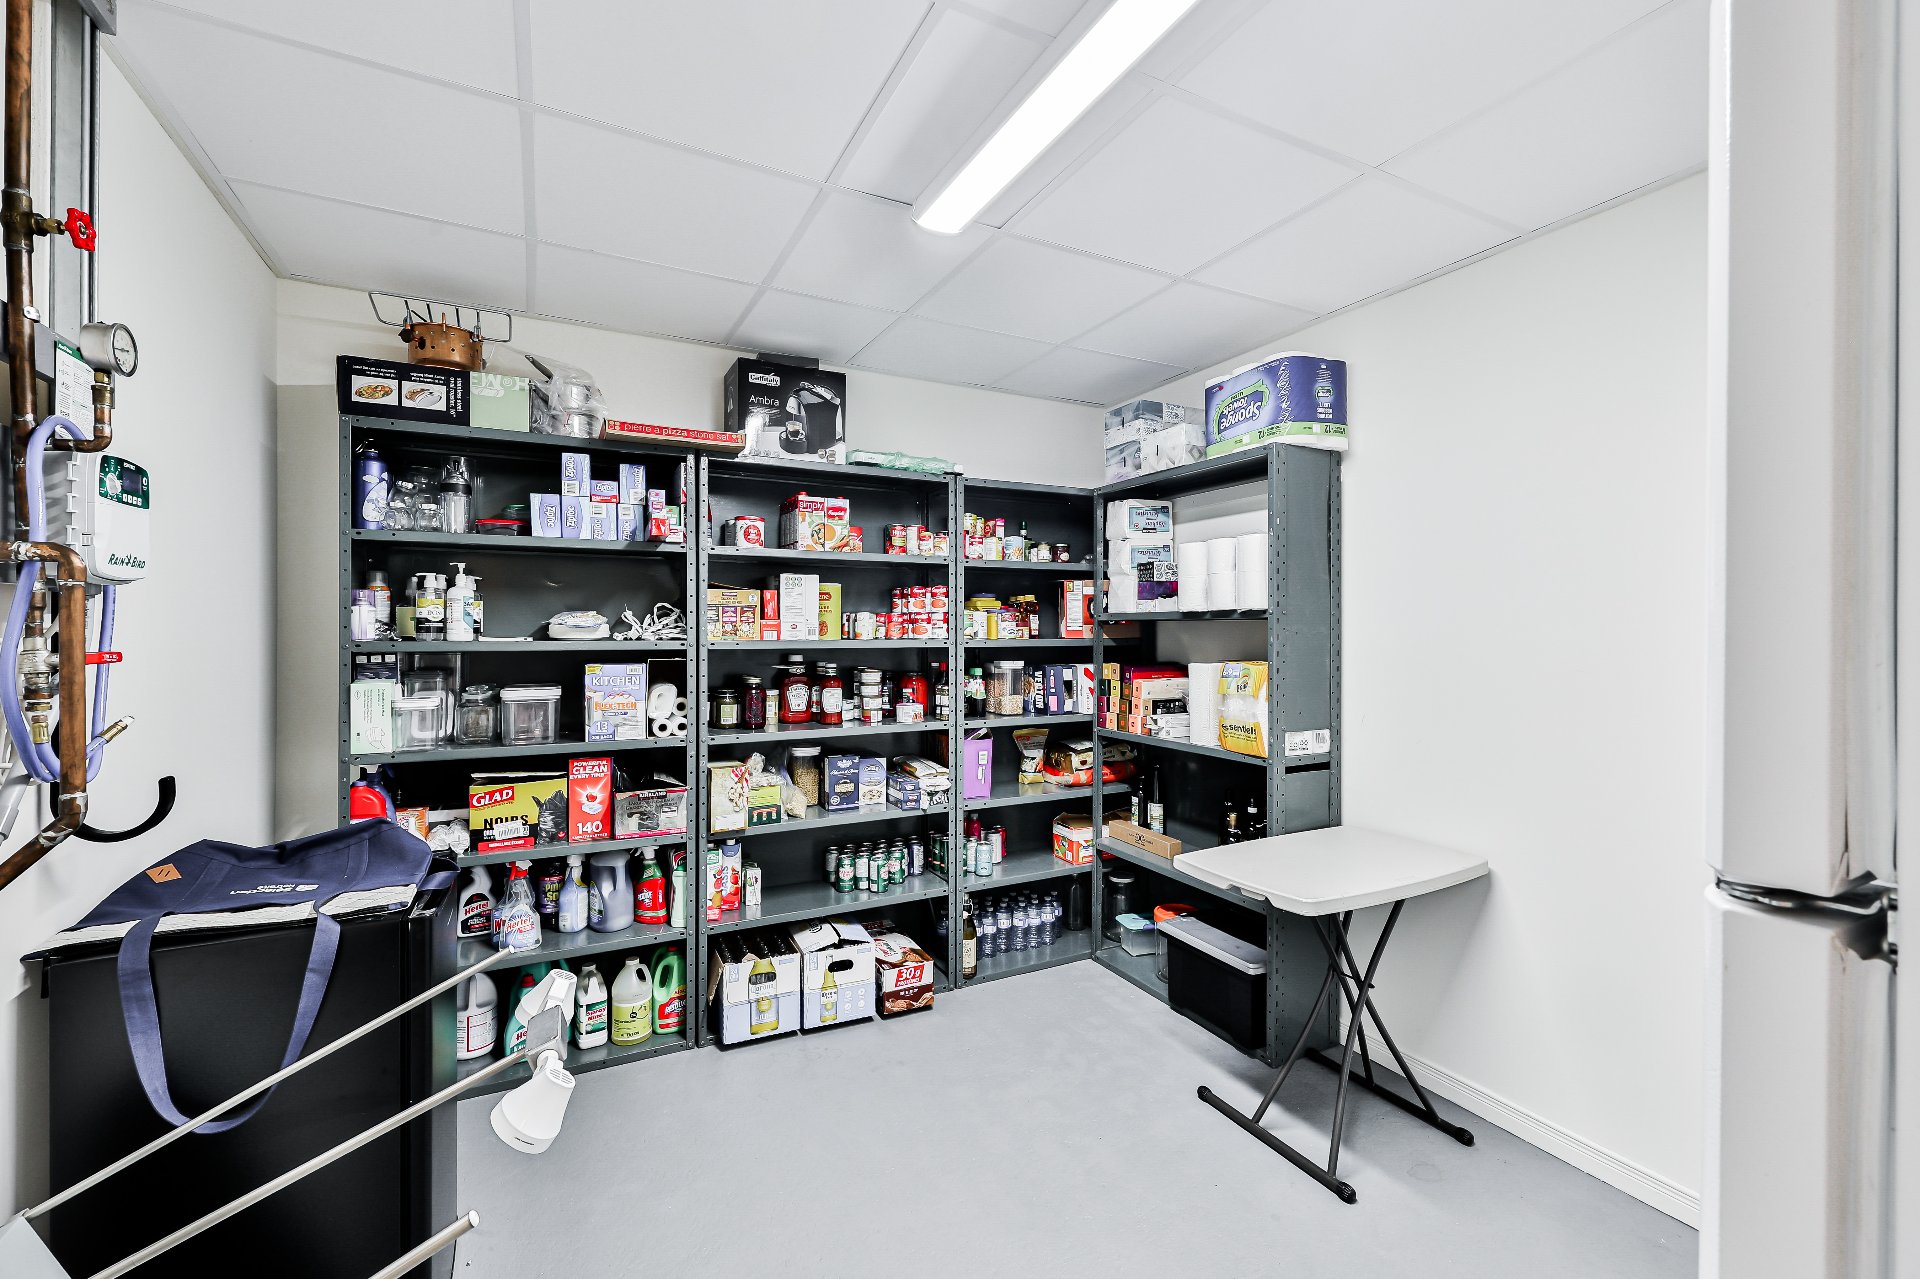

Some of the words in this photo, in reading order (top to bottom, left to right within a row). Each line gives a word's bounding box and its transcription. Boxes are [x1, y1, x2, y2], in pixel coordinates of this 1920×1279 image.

[749, 394, 780, 406] Ambra
[1223, 397, 1248, 415] Towels
[1220, 401, 1262, 430] Sponge
[624, 423, 652, 433] pierre
[662, 428, 688, 437] pizza
[565, 456, 576, 478] Ziploc
[800, 500, 824, 511] simply
[544, 504, 556, 528] Ziploc
[566, 506, 576, 528] Ziploc
[592, 676, 640, 686] KITCHEN
[596, 722, 608, 730] 13
[572, 765, 608, 774] CLEAN
[472, 788, 513, 807] GLAD
[576, 820, 603, 834] 140
[464, 902, 489, 916] Hertel
[506, 916, 532, 931] Hertel
[898, 968, 914, 980] 30
